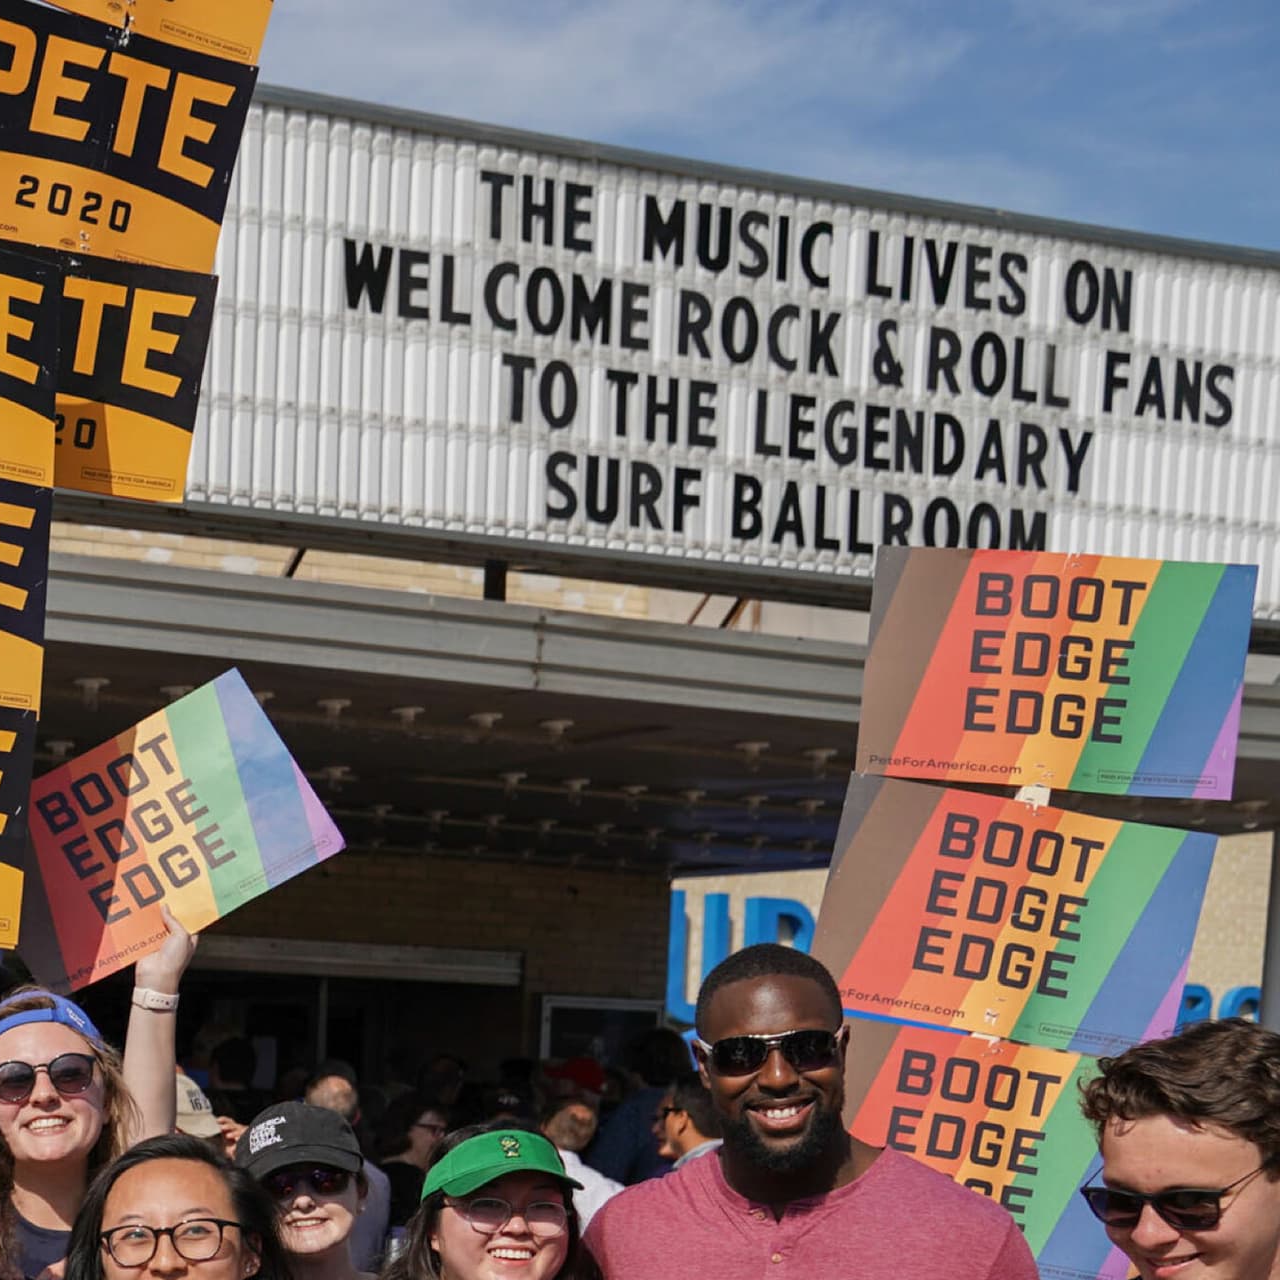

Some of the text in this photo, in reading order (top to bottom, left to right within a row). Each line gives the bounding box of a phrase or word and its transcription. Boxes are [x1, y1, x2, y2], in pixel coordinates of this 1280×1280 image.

[15, 174, 132, 233] 2020
[479, 169, 1133, 333] THE MUSIC LIVES ON
[62, 275, 197, 398] TE
[342, 236, 1236, 429] WELCOME ROCK & ROLL FANS
[502, 352, 1093, 494] TO THE LEGENDARY
[544, 451, 1047, 554] SURF BALLROOM
[975, 571, 1147, 626] BOOT
[969, 630, 1136, 686] EDGE
[963, 687, 1128, 744] EDGE
[35, 732, 176, 836] BOOT
[868, 754, 1022, 776] PeteForAmerica.com
[60, 778, 210, 881] EDGE
[938, 812, 1105, 883] BOOT
[88, 822, 238, 926] EDGE
[925, 869, 1089, 942] EDGE
[912, 926, 1076, 999] EDGE
[896, 1049, 1062, 1117] BOOT
[886, 1106, 1046, 1176] EDGE
